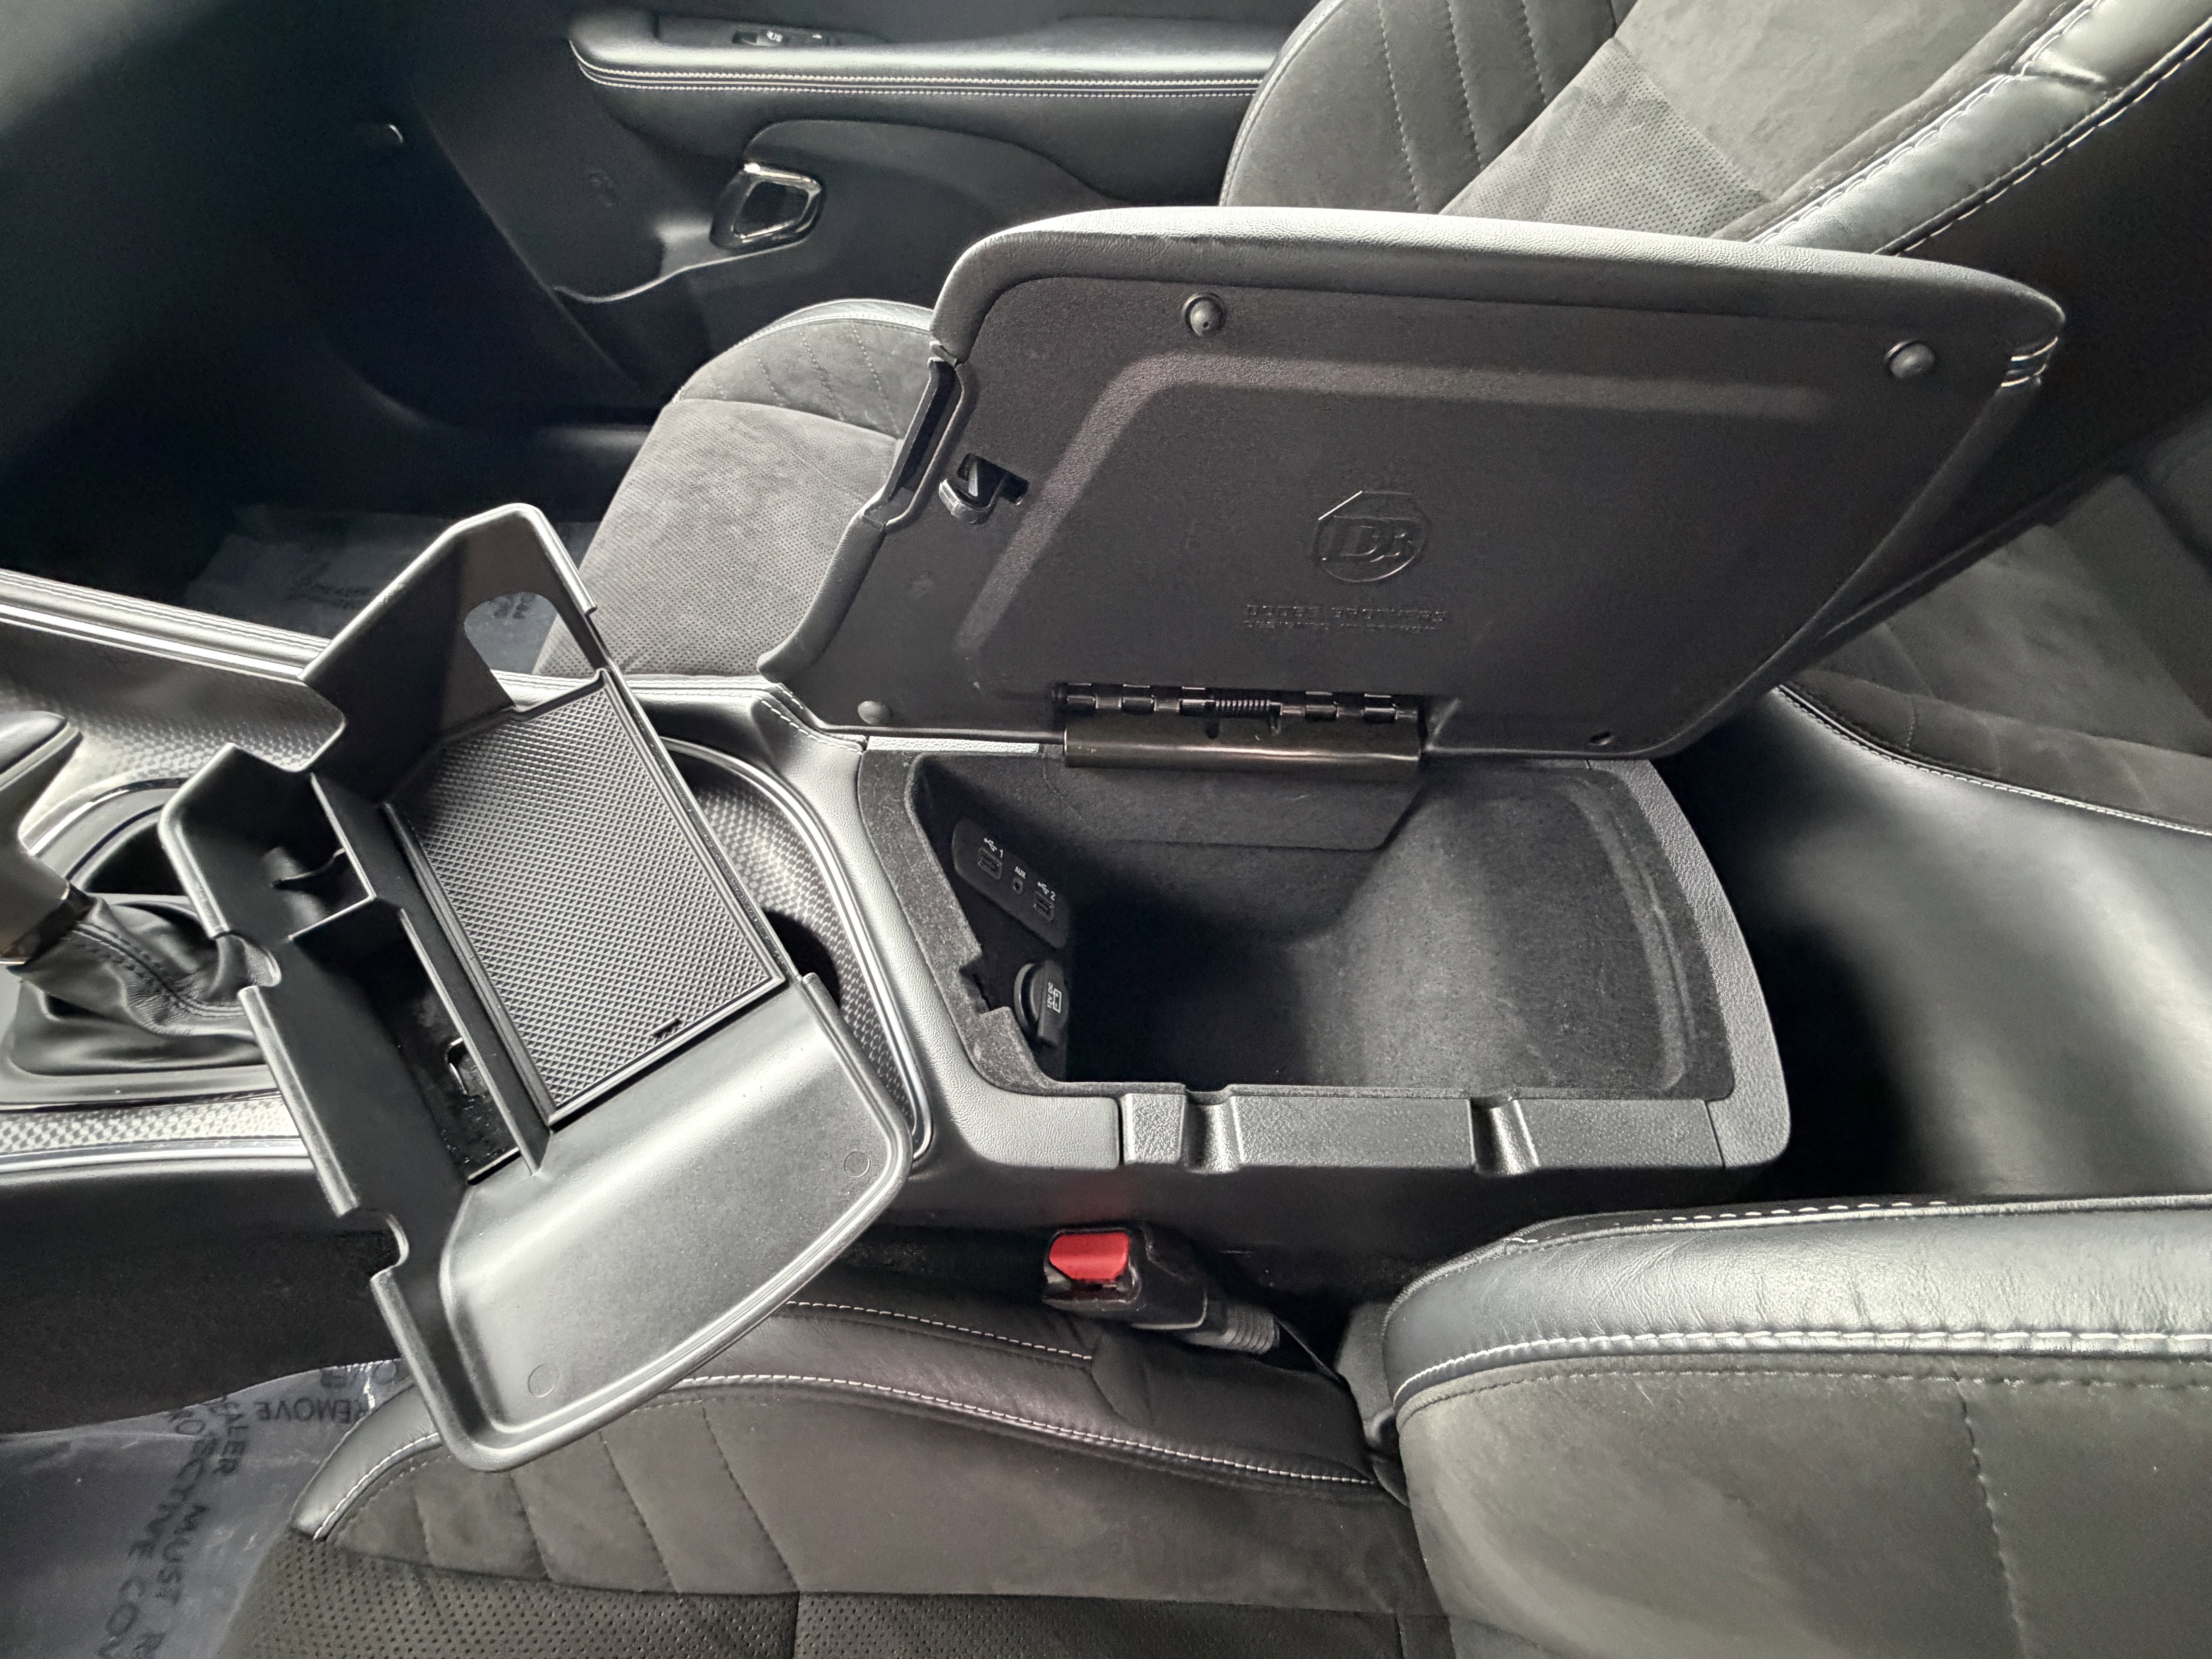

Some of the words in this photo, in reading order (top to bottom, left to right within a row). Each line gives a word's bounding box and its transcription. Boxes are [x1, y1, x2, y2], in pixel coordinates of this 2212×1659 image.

[999, 849, 1004, 858] 1
[1014, 866, 1026, 879] AUX
[1050, 891, 1055, 901] 2
[1048, 981, 1053, 994] DC
